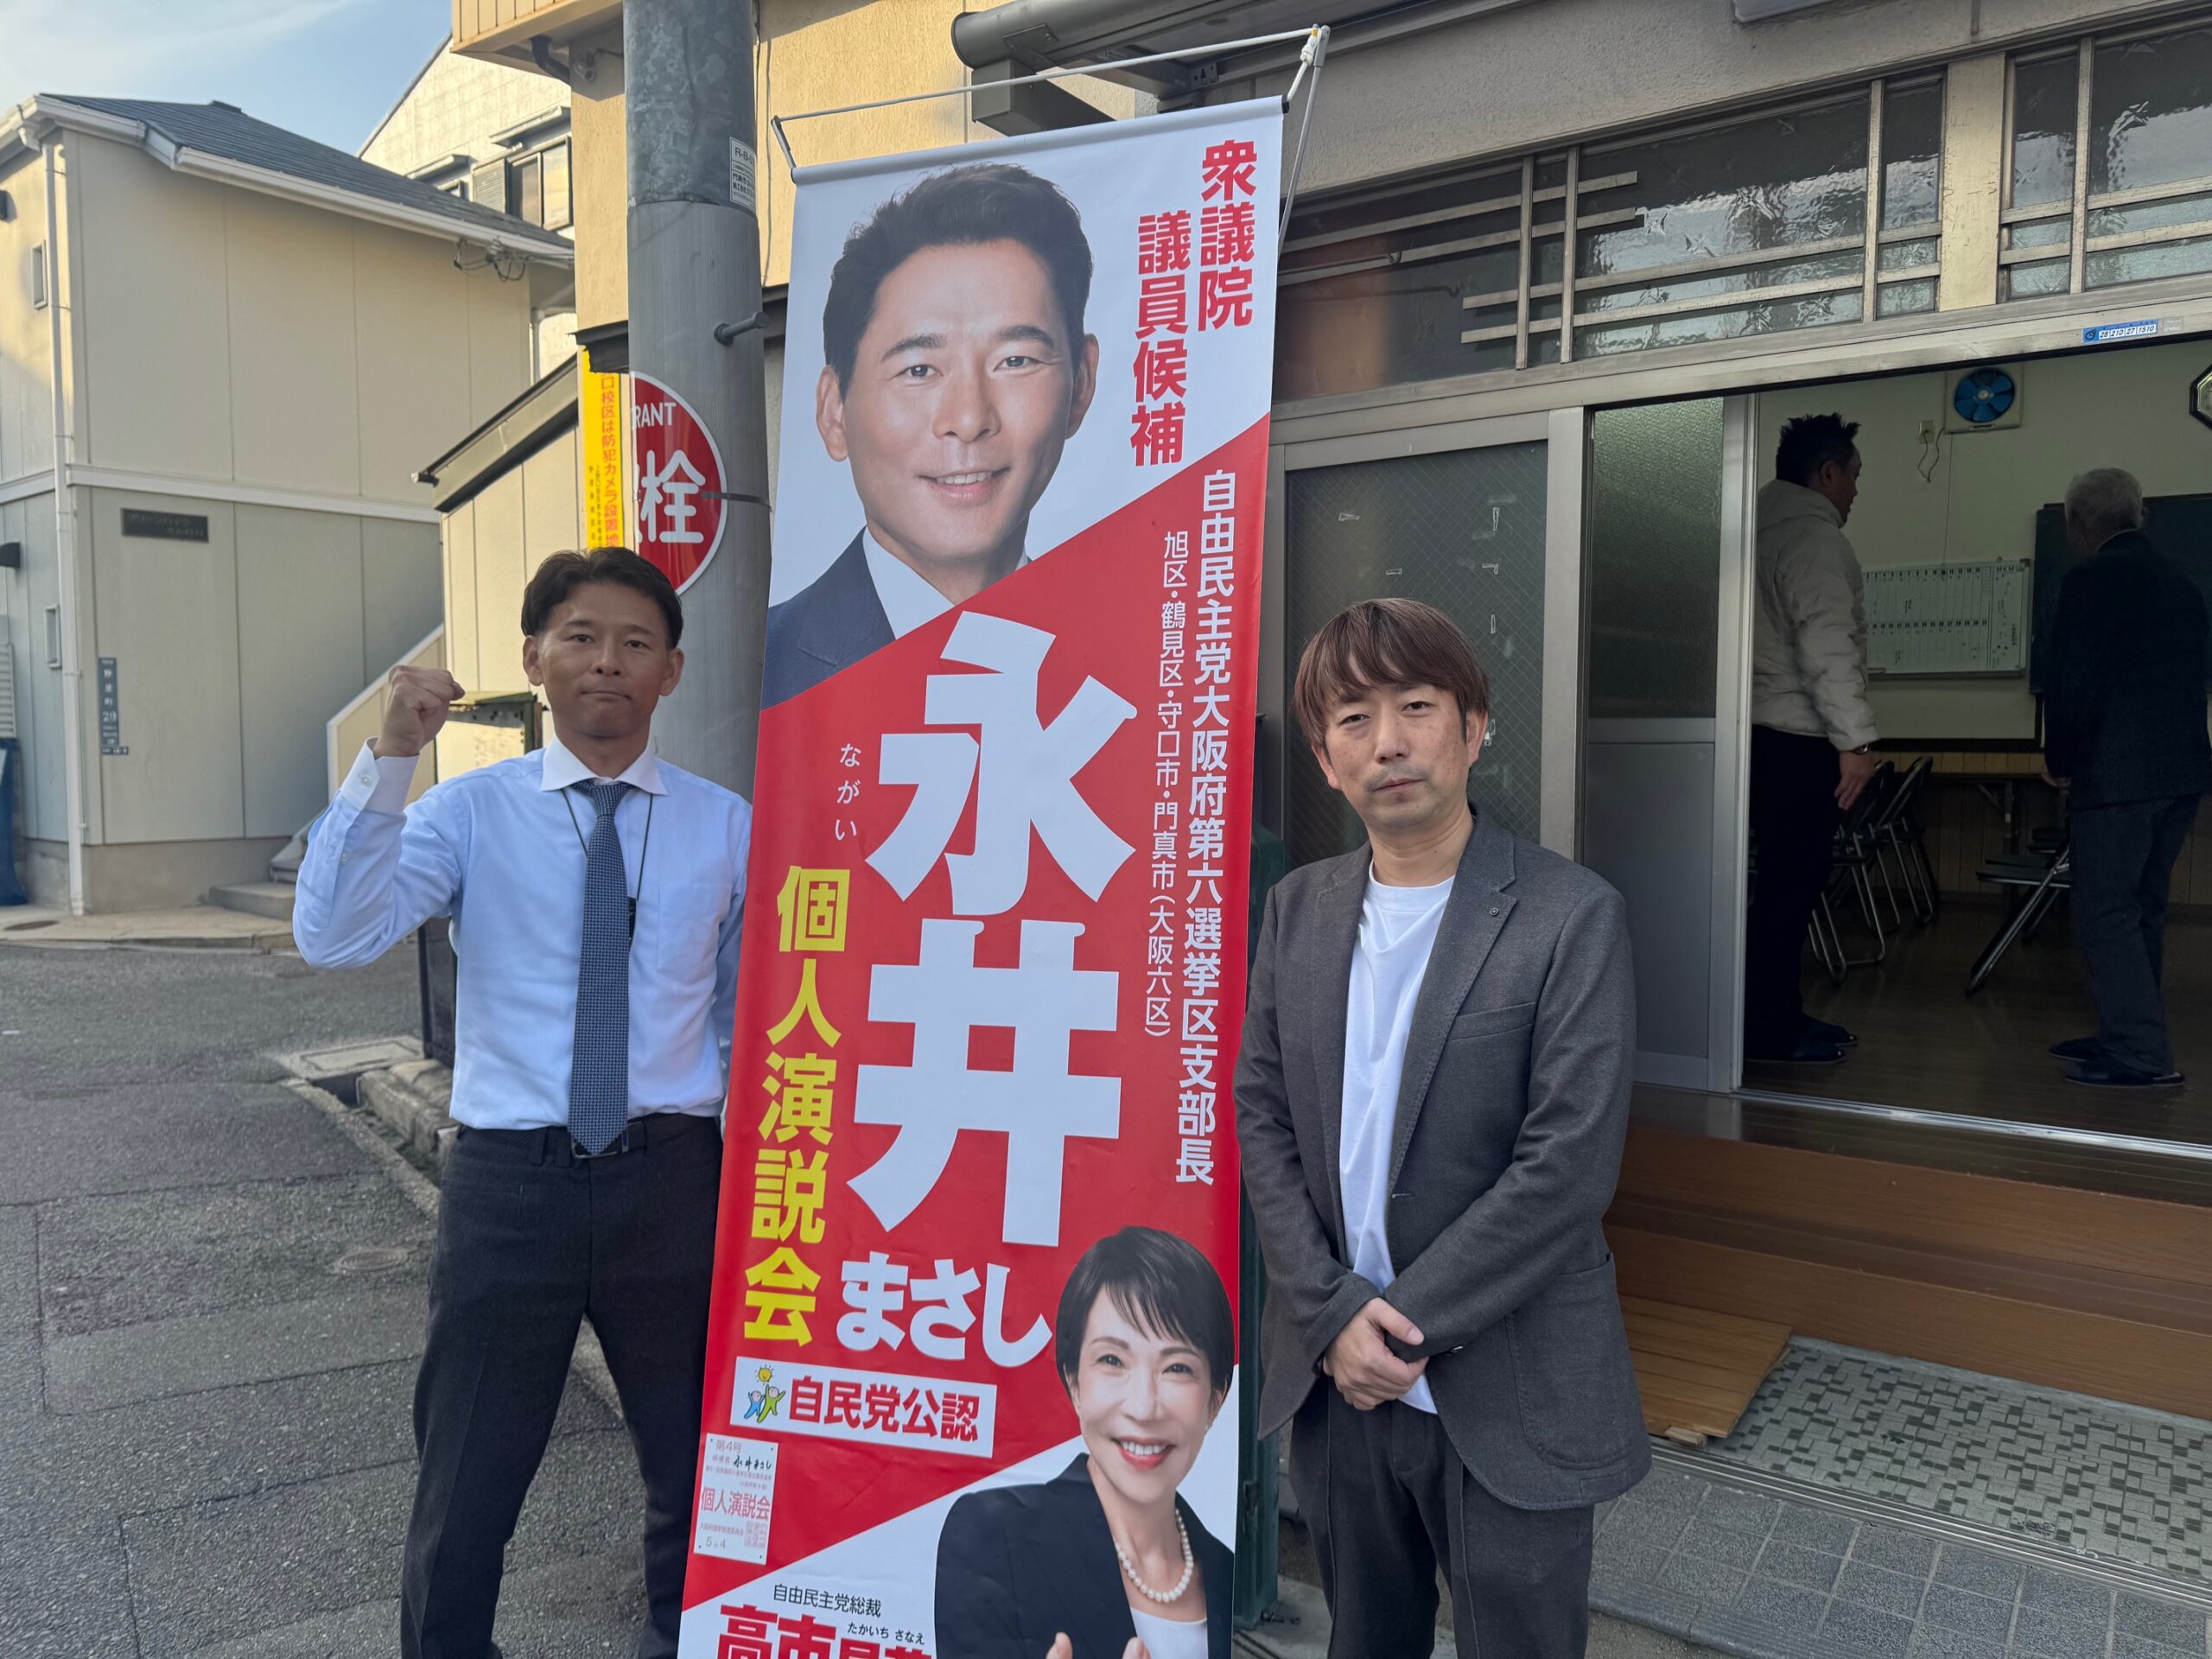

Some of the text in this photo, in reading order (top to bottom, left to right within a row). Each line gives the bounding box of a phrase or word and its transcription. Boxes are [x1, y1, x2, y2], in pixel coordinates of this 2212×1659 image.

[1198, 139, 1258, 332] 衆議院
[1129, 210, 1192, 467] 議員候補
[2139, 325, 2155, 334] 1510
[601, 373, 620, 547] 口校区は防犯カメラ設置地
[633, 449, 707, 543] 栓
[834, 743, 862, 843] ながい
[1144, 531, 1189, 1037] 旭区・鶴見区・守口市・門真市（大阪六区）
[1175, 469, 1236, 1186] 自由民主党大阪府第六選挙区支部長
[847, 611, 1138, 1247] 永井
[745, 865, 851, 1348] 個人演説会
[836, 1253, 1053, 1369] まさし
[715, 1440, 742, 1453] 第4号
[789, 1375, 981, 1443] 自民党公認
[701, 1486, 771, 1521] 個人演説会
[716, 1604, 932, 1659] 高市
[773, 1584, 882, 1618] 自由民主党総裁
[847, 1621, 925, 1645] たかいち さなえ
